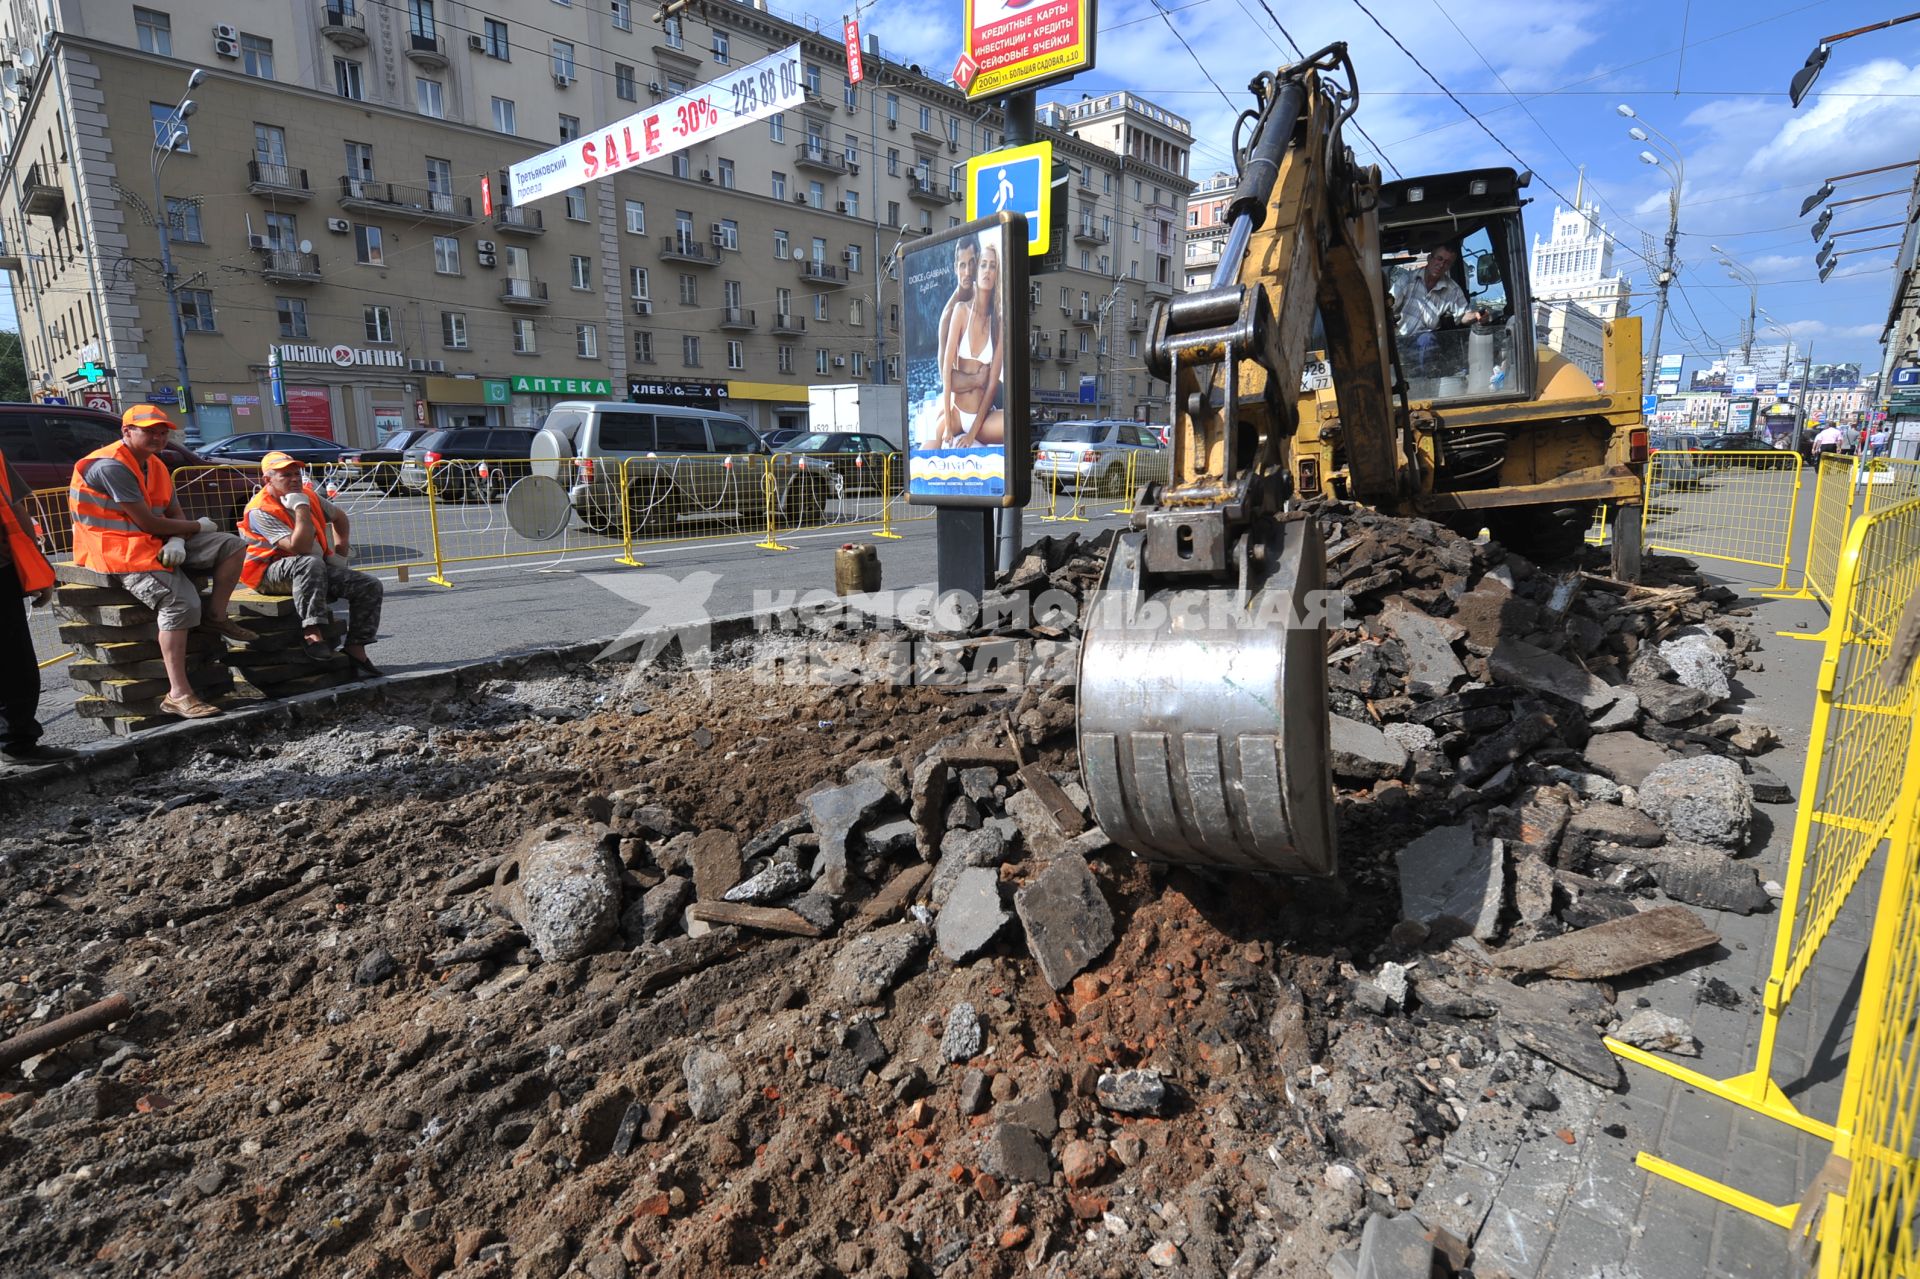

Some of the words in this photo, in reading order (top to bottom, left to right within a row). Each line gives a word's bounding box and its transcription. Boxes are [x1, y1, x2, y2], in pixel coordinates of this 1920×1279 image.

[975, 32, 1026, 57] ИНВЕСТИЦИИ
[1033, 17, 1074, 38] КРЕДИТЫ
[981, 15, 1033, 40] КРЕДИТНЫЕ
[1037, 3, 1068, 22] КАРТЫ
[980, 46, 1029, 69] СЕЙФОВЫЕ
[1033, 33, 1070, 53] ЯЧЕЙКИ
[1009, 64, 1037, 78] БОЛЬШАЯ
[732, 76, 757, 117] 225
[759, 68, 777, 107] 88
[779, 60, 797, 100] 00
[581, 114, 662, 178] SALE
[672, 94, 718, 137] -30%
[515, 155, 567, 186] Третьяковский
[517, 182, 542, 199] проезд
[517, 377, 607, 394] АПТЕКА
[1316, 378, 1328, 388] 77
[91, 401, 107, 410] 24
